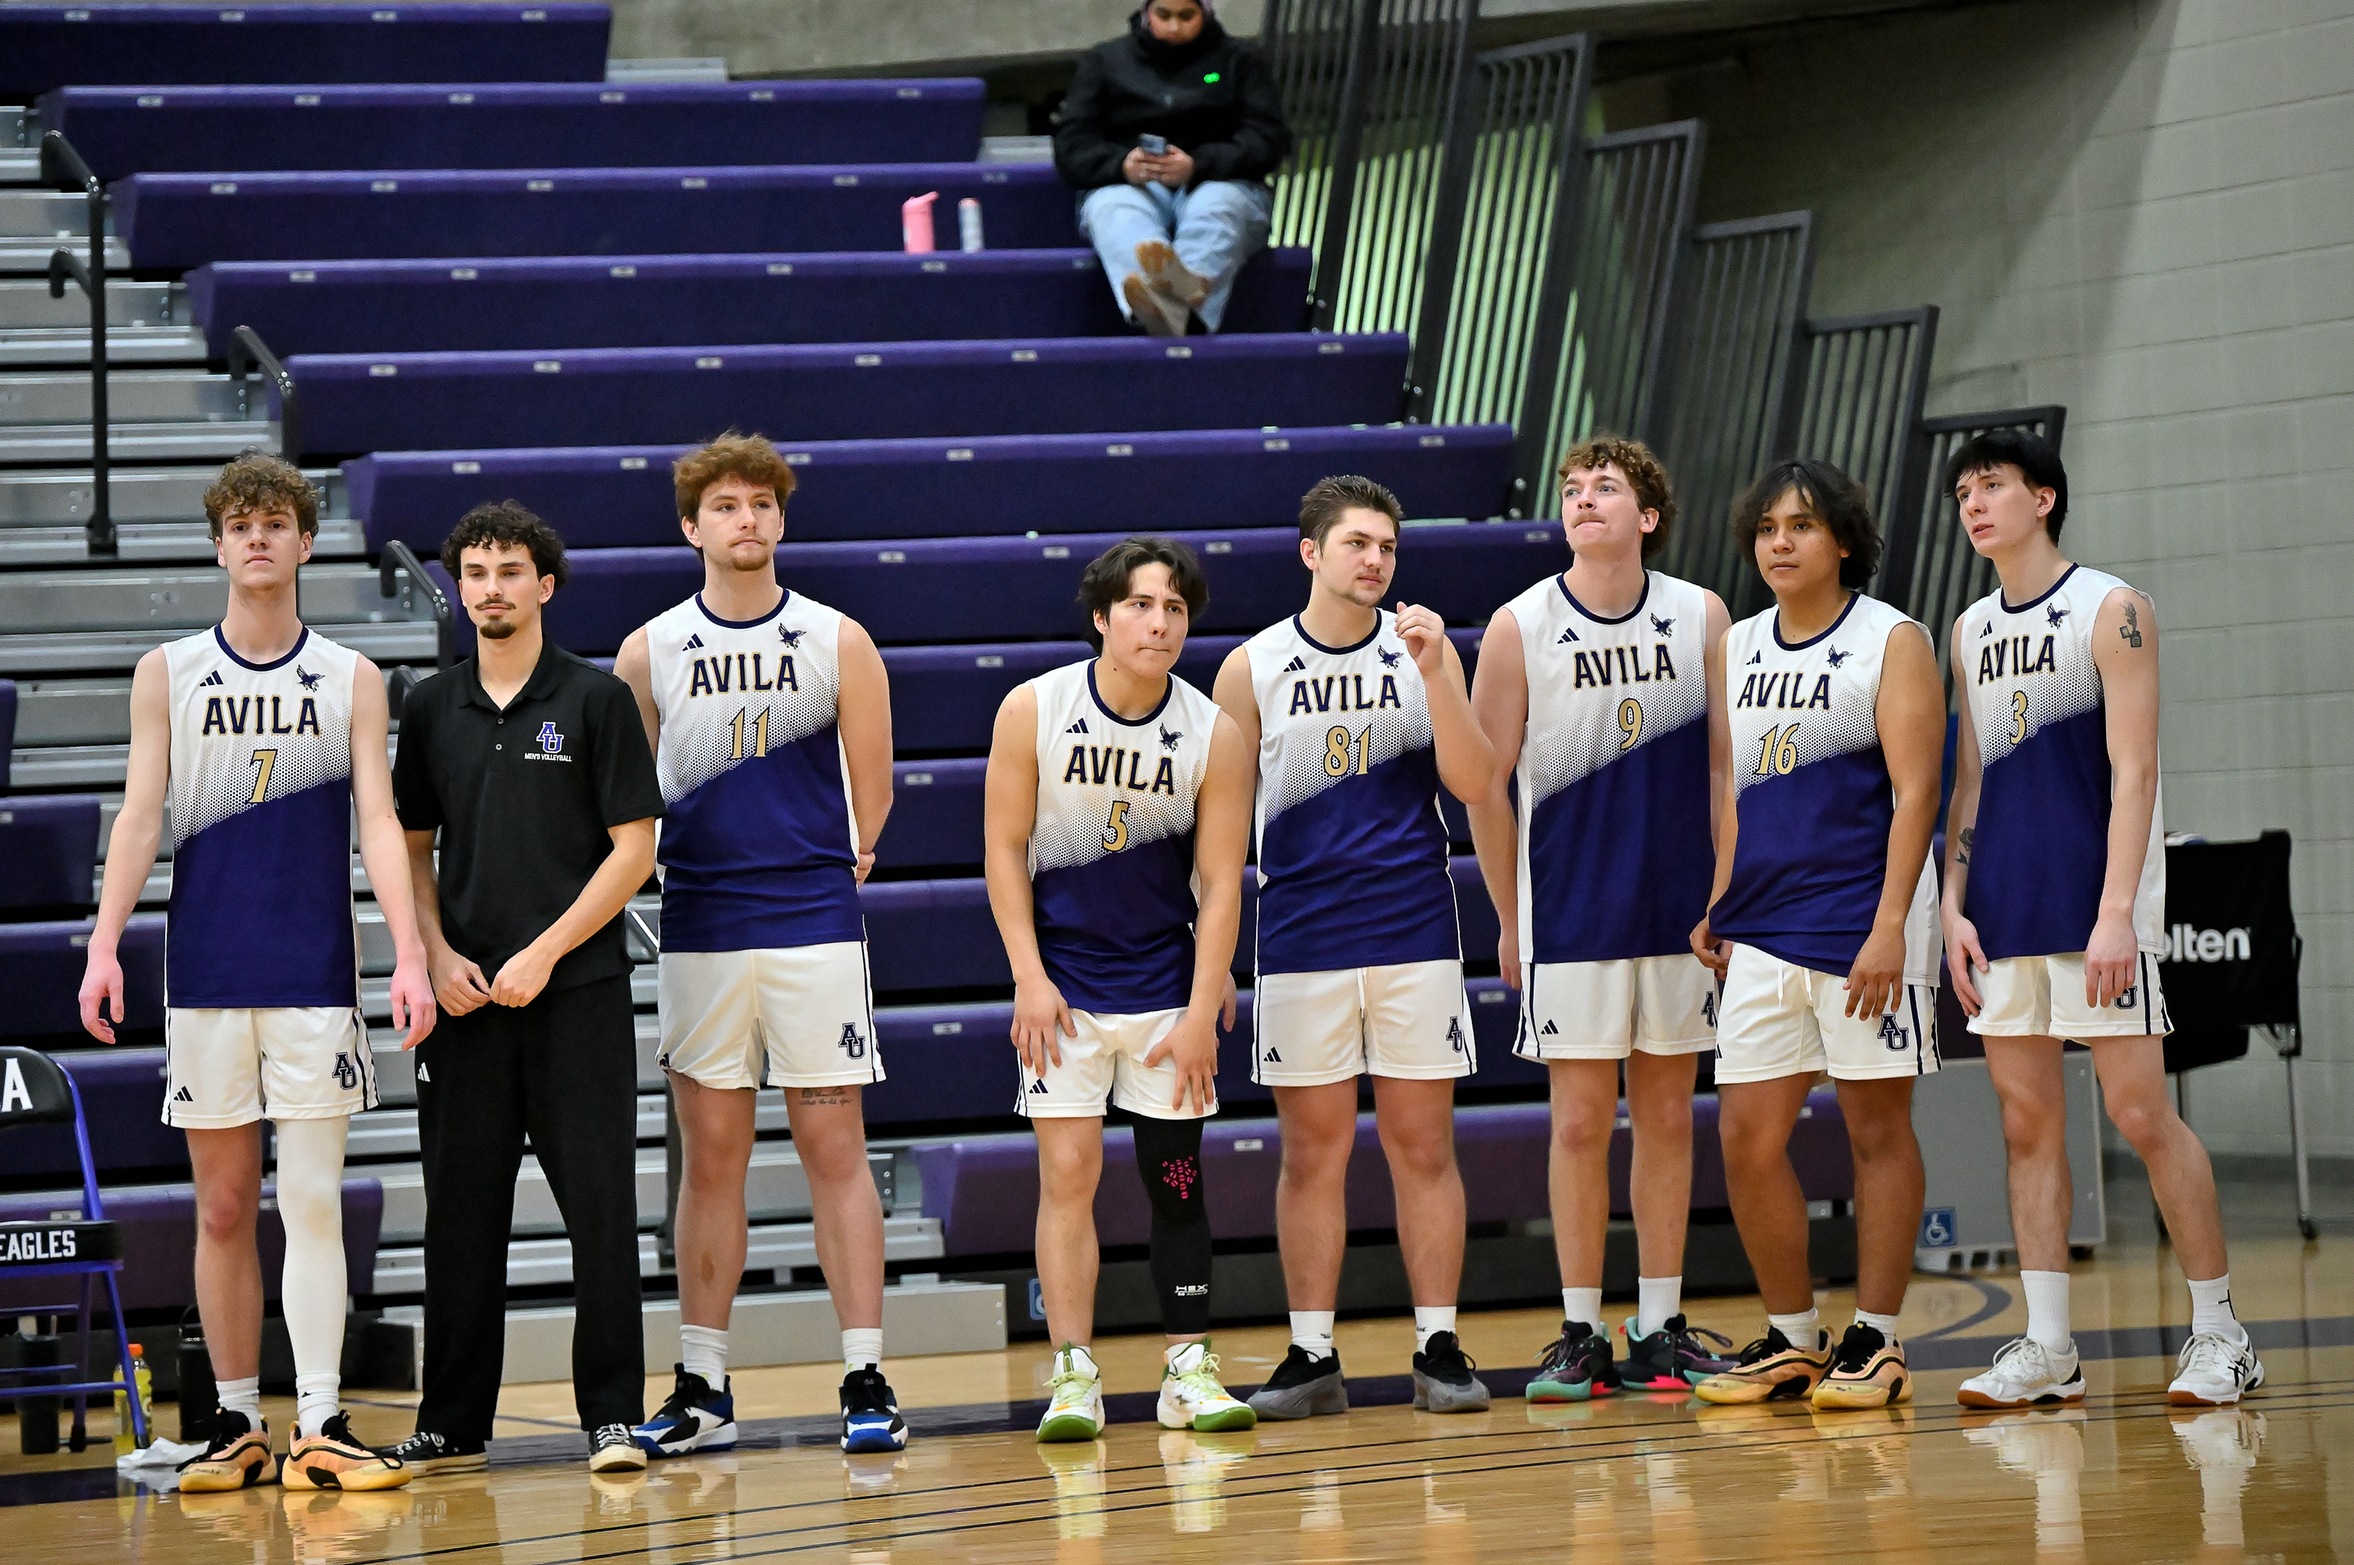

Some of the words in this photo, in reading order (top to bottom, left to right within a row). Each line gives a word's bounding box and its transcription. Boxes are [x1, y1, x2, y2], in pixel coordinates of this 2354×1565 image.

[690, 653, 798, 697] AVILA
[1574, 644, 1676, 689] AVILA
[1978, 635, 2055, 686] AVILA
[1289, 674, 1401, 716] AVILA
[1737, 672, 1830, 710] AVILA
[202, 695, 319, 737] AVILA
[536, 721, 565, 754] AU
[729, 705, 770, 760] 11
[1617, 698, 1643, 750] 9
[2010, 690, 2028, 745] 3
[524, 752, 541, 761] MEN'S
[541, 754, 572, 762] VOLLEYBALL
[1063, 744, 1174, 796] AVILA
[1323, 723, 1371, 777] 81
[1754, 722, 1800, 775] 16
[248, 748, 278, 803] 7
[1102, 800, 1130, 851] 5
[838, 1022, 866, 1059] AU
[1877, 1013, 1909, 1051] AU
[332, 1052, 358, 1090] AU
